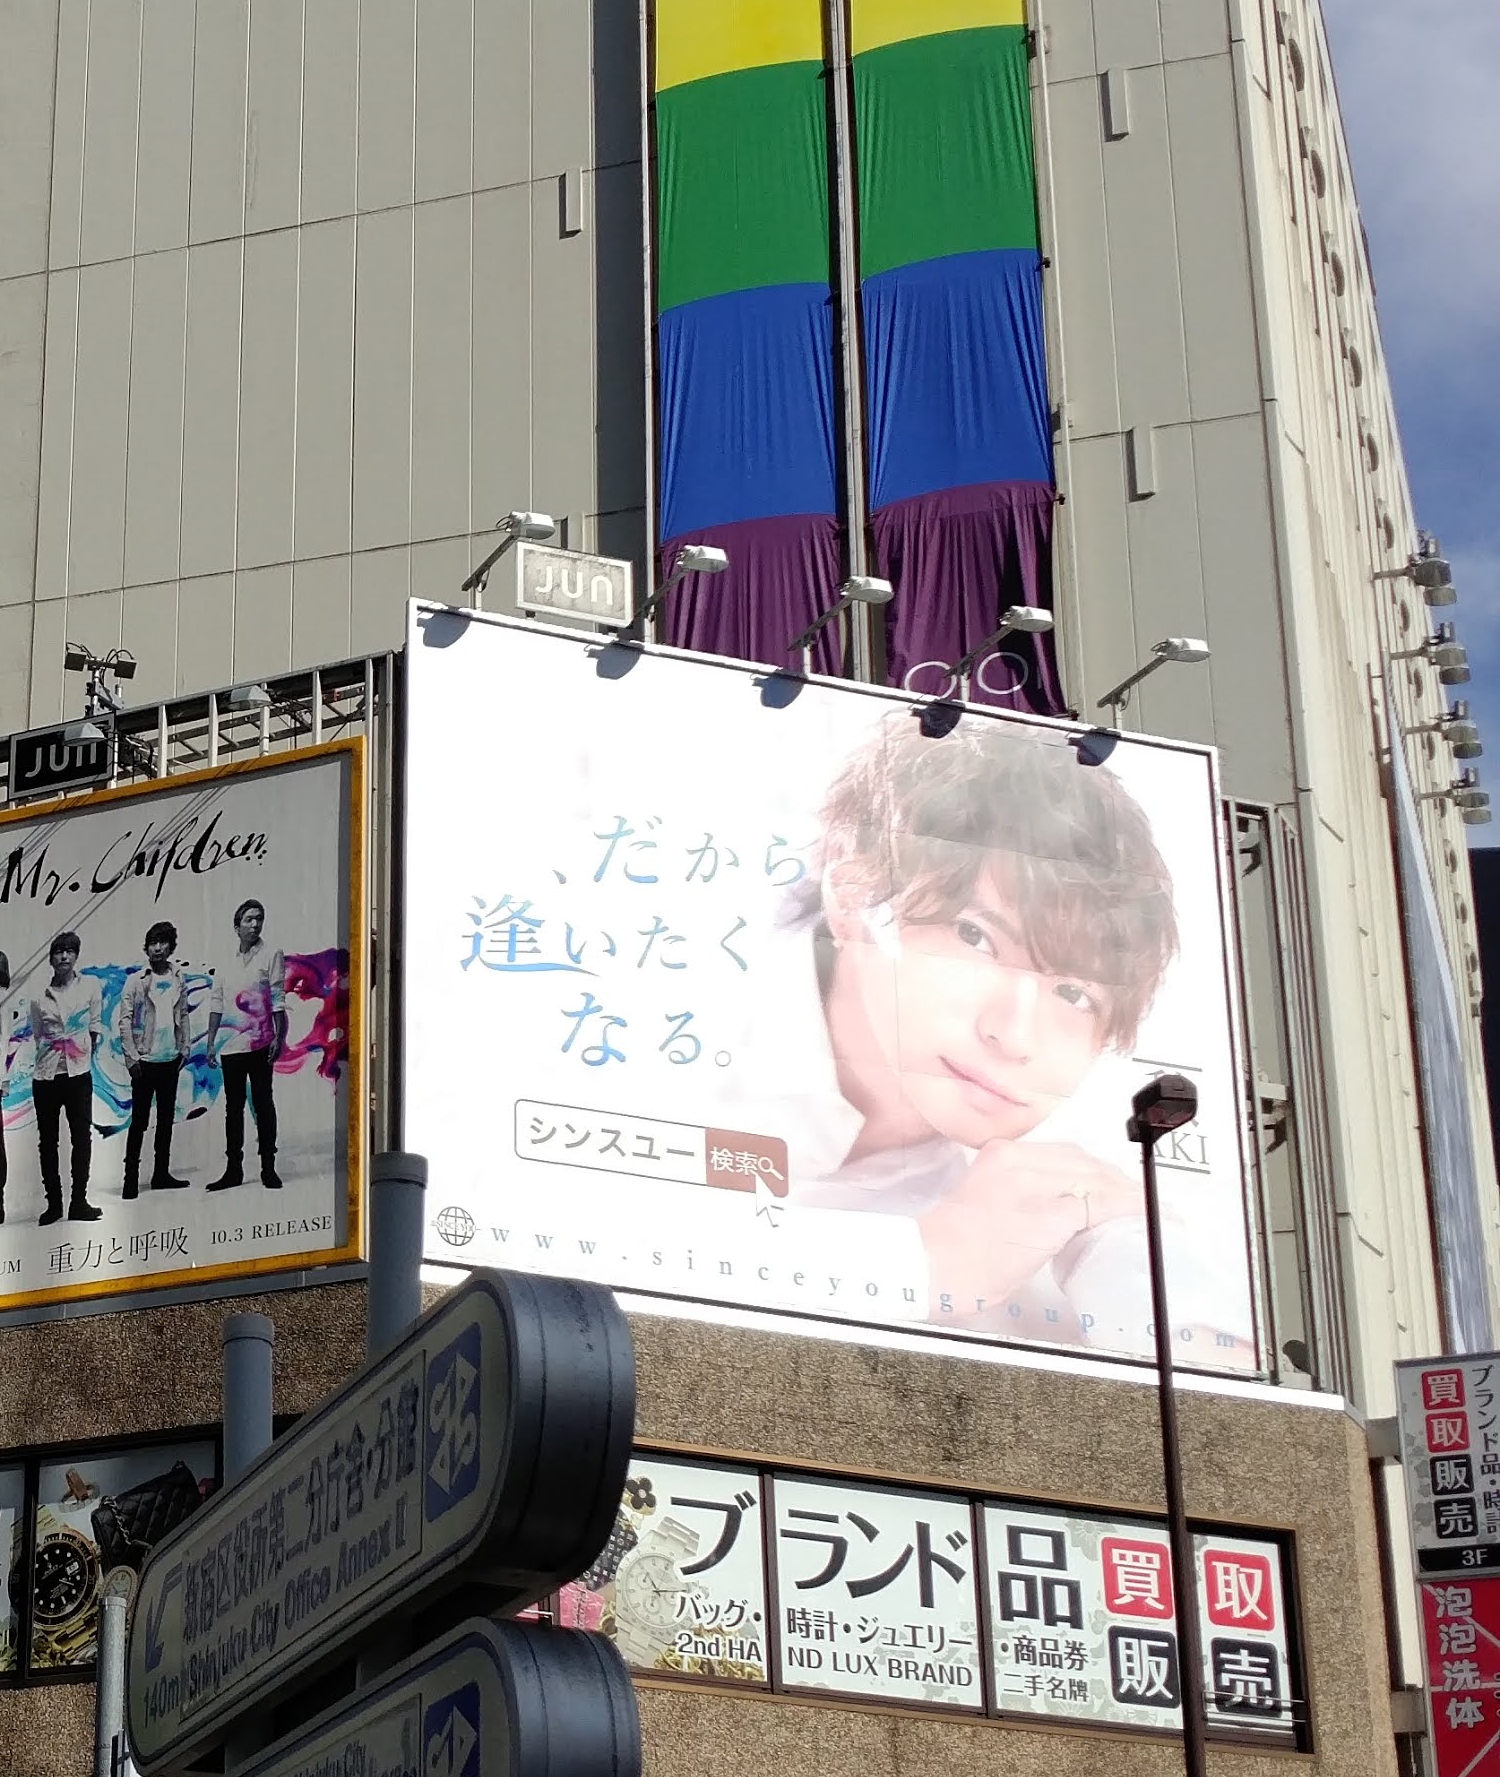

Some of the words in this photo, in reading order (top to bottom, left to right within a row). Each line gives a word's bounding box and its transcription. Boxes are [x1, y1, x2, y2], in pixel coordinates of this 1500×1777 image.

[91, 811, 269, 904] Children
[460, 894, 751, 975] 逢いたく
[528, 1113, 696, 1164] シンスユー
[709, 1144, 759, 1177] 検索
[47, 1226, 190, 1276] 重力と呼吸
[209, 1227, 244, 1245] 10.3
[251, 1215, 333, 1240] RELEASE
[1426, 1373, 1475, 1536] 買取販売
[1461, 1549, 1489, 1567] 3F
[143, 1676, 180, 1726] 140m
[189, 1625, 248, 1701] Shinjuku
[250, 1602, 280, 1652] City
[285, 1565, 331, 1629] Office
[336, 1519, 392, 1592] Annex
[1435, 1585, 1485, 1729] 泡泡洗体
[677, 1635, 723, 1660] 2nd
[831, 1650, 880, 1677] LUX
[888, 1654, 973, 1687] BRAND
